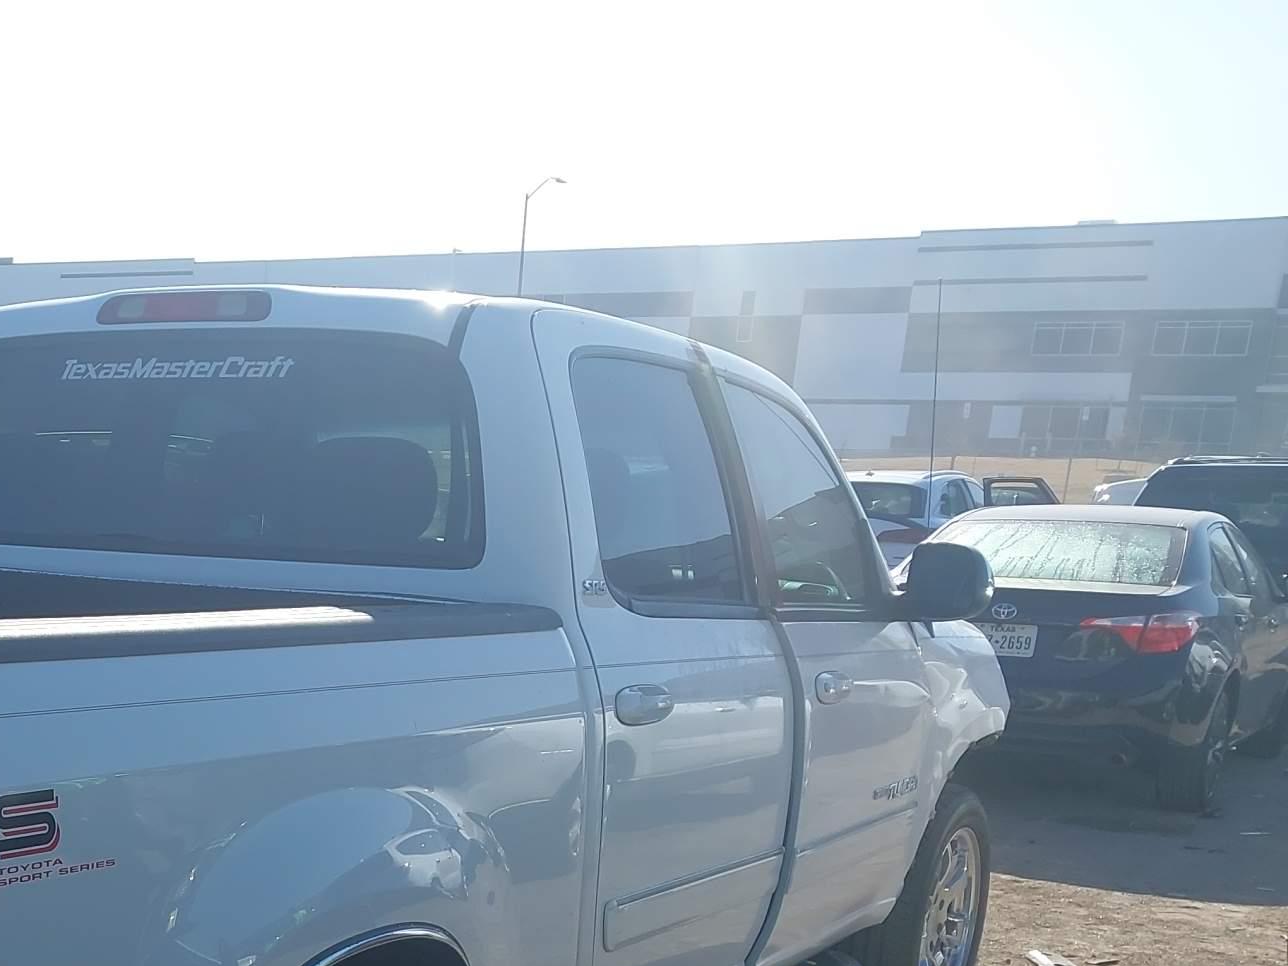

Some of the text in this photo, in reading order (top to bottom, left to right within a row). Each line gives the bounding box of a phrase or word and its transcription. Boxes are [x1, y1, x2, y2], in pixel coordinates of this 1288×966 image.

[61, 356, 295, 380] TexasMasterCraft
[990, 625, 1016, 633] TEXAS
[58, 858, 116, 876] SERIES
